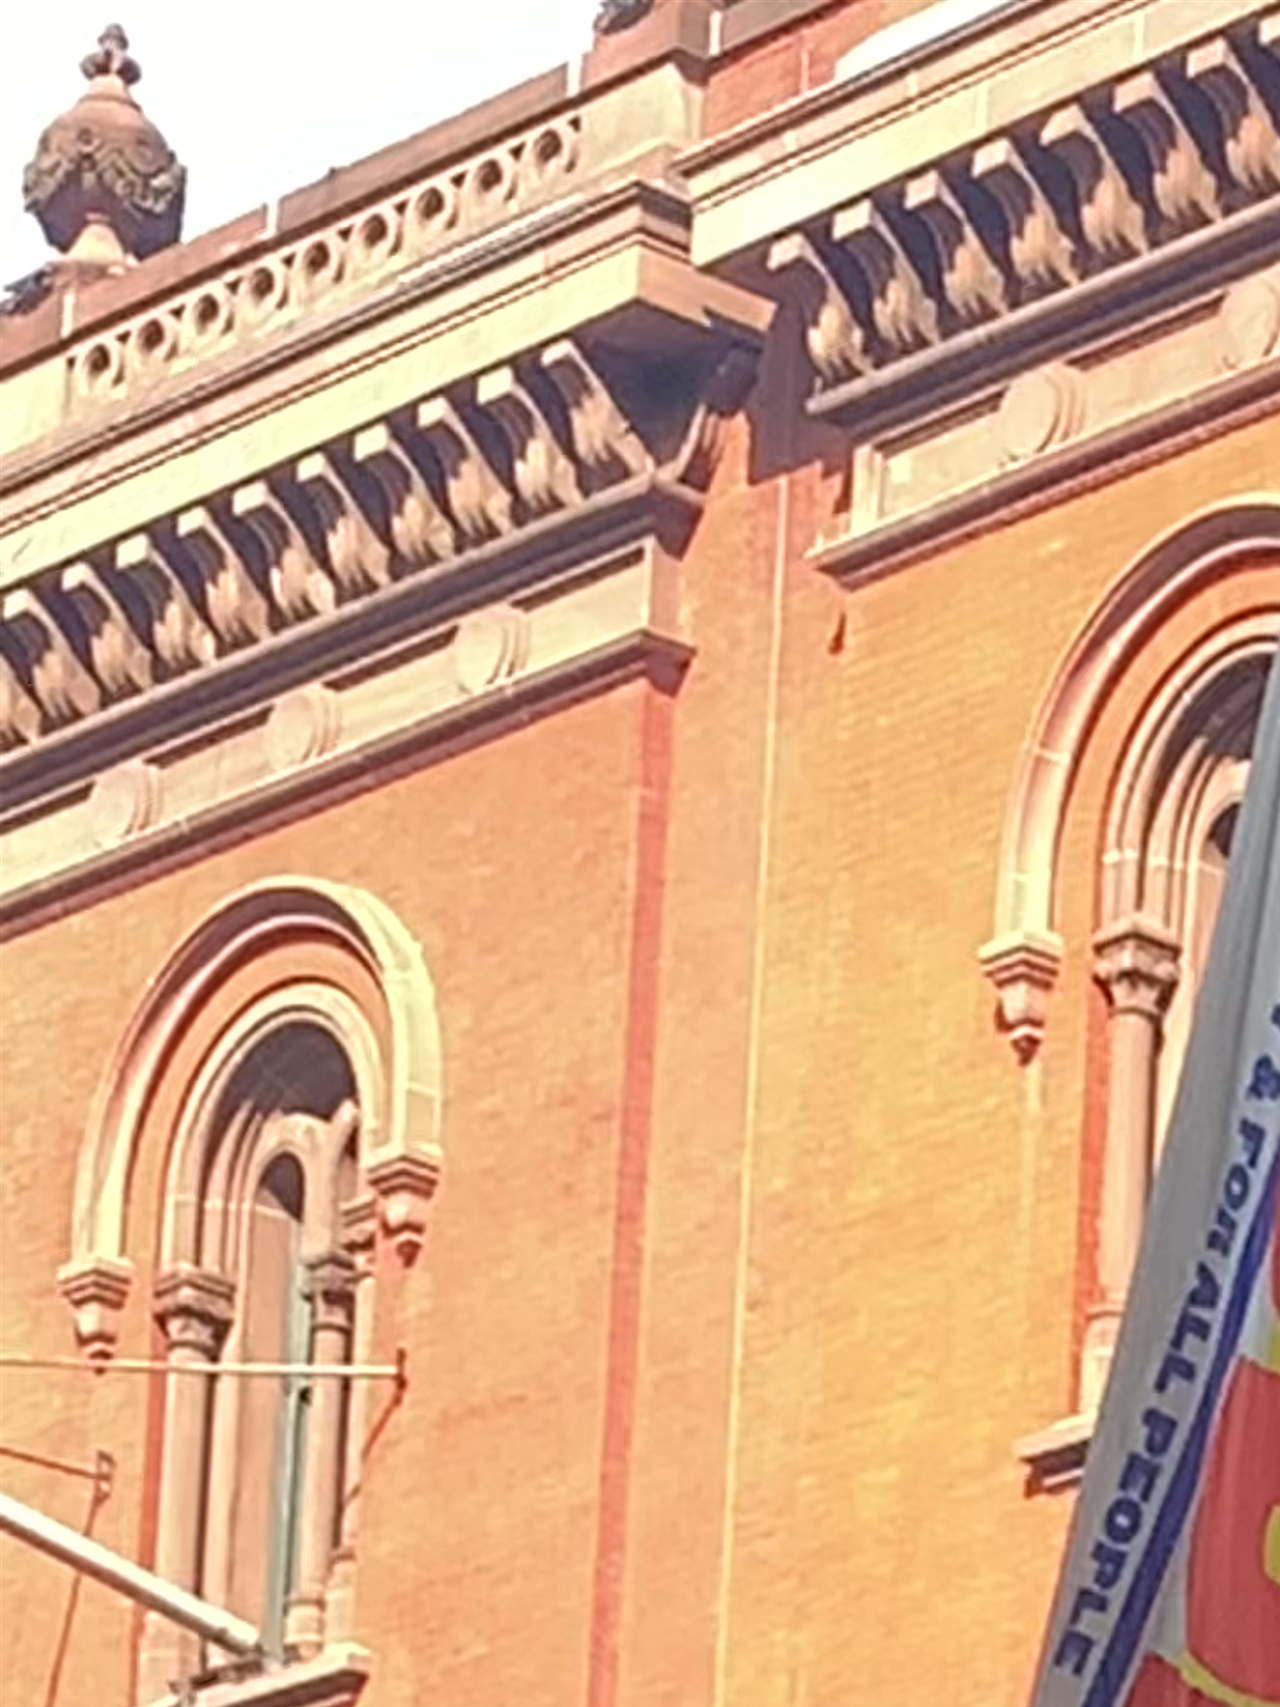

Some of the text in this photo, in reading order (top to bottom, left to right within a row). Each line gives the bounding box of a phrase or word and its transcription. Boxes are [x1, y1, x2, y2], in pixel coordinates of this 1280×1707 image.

[1207, 1117, 1267, 1258] FOR
[1154, 1260, 1221, 1395] ALL
[1054, 1407, 1178, 1677] PEOPLE
